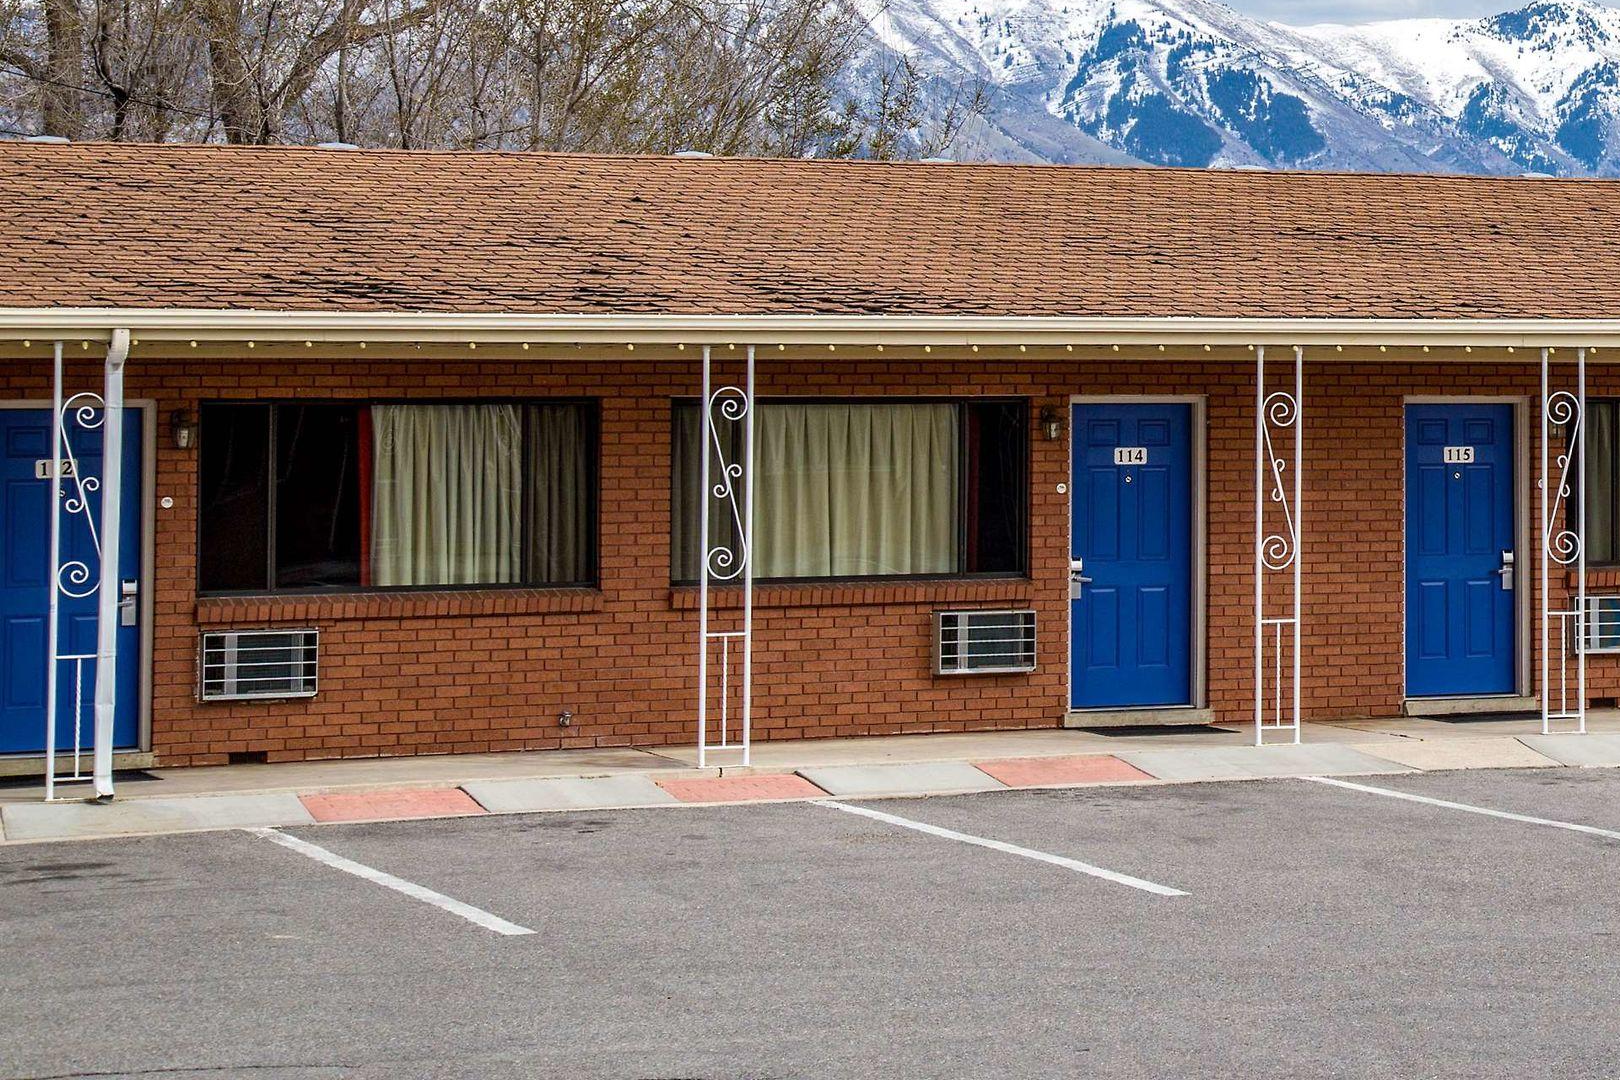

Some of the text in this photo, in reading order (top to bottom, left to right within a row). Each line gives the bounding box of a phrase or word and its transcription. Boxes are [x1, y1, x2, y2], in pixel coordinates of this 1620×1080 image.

[1118, 449, 1143, 463] 114
[1447, 448, 1471, 461] 115
[41, 461, 73, 476] 12
